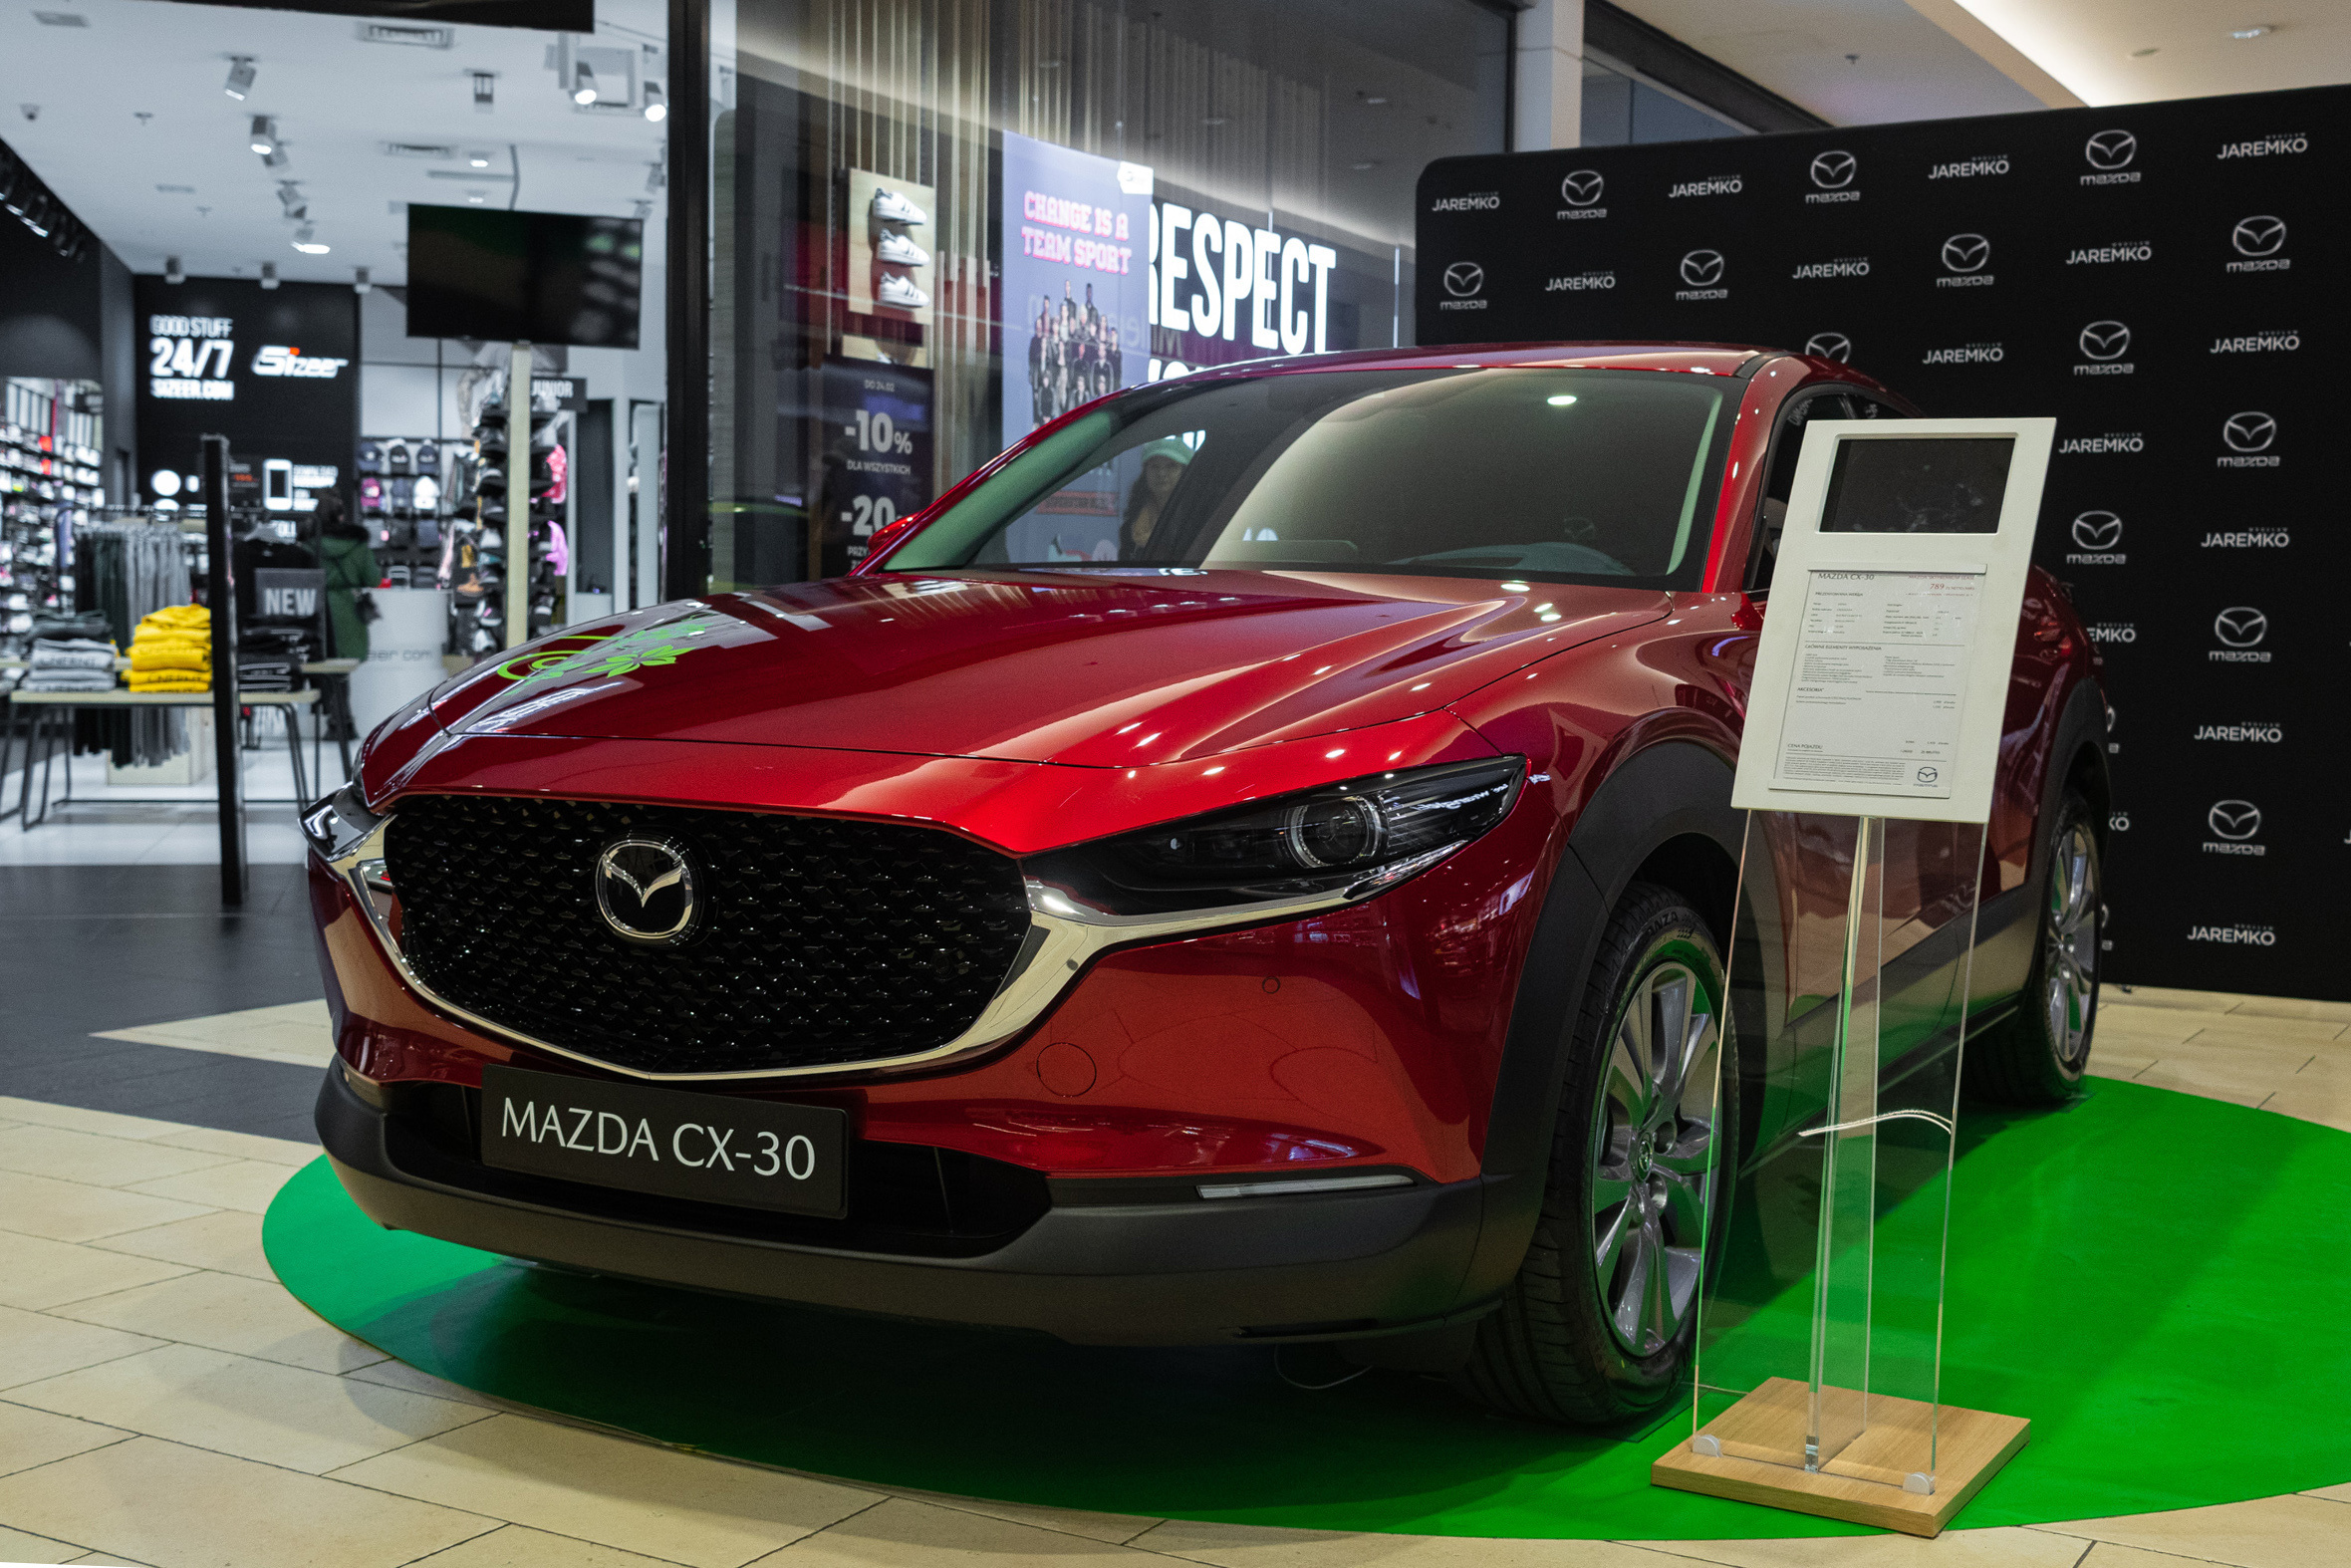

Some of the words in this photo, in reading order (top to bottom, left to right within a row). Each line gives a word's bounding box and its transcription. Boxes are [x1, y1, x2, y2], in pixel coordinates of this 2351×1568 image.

[2217, 136, 2308, 159] JAREMKO
[1928, 159, 2009, 179] JAREMKO
[2080, 171, 2141, 185] mazda
[1669, 178, 1742, 198] JAREMKO
[1433, 196, 1499, 212] JAREMKO
[1805, 190, 1860, 204] mazda
[1024, 190, 1092, 234] CHANGE
[1094, 207, 1113, 238] IS
[1115, 212, 1129, 241] A
[1557, 207, 1607, 220] mazda
[1021, 225, 1072, 265] TEAM
[1073, 238, 1132, 275] SPORT
[2066, 245, 2152, 265] JAREMKO
[1792, 262, 1870, 279] JAREMKO
[2226, 258, 2290, 273] mazda
[1545, 276, 1616, 291] JAREMKO
[1937, 274, 1994, 288] mazda
[1676, 289, 1727, 300] mazda
[1440, 299, 1487, 310] mazda
[150, 315, 189, 336] GOOD
[190, 316, 232, 338] STUFF
[2210, 335, 2300, 355] JAREMKO
[150, 338, 234, 379] 24/7
[1923, 347, 2003, 365] JAREMKO
[2074, 363, 2134, 376] mazda
[845, 409, 913, 454] -10%
[2059, 437, 2144, 453] JAREMKO
[847, 459, 863, 471] DLA
[864, 460, 911, 475] WSZYSTKICH
[2218, 455, 2280, 467] mazda
[2201, 532, 2289, 548] JAREMKO
[2066, 553, 2126, 565] mazda
[264, 588, 316, 616] NEW
[2086, 628, 2136, 644] EMKO
[2209, 651, 2271, 662] mazda
[2195, 725, 2282, 743] JAREMKO
[2203, 841, 2265, 856] mazda
[2188, 925, 2275, 946] JAREMKO
[501, 1097, 659, 1162] MAZDA
[671, 1122, 816, 1181] CX-30
